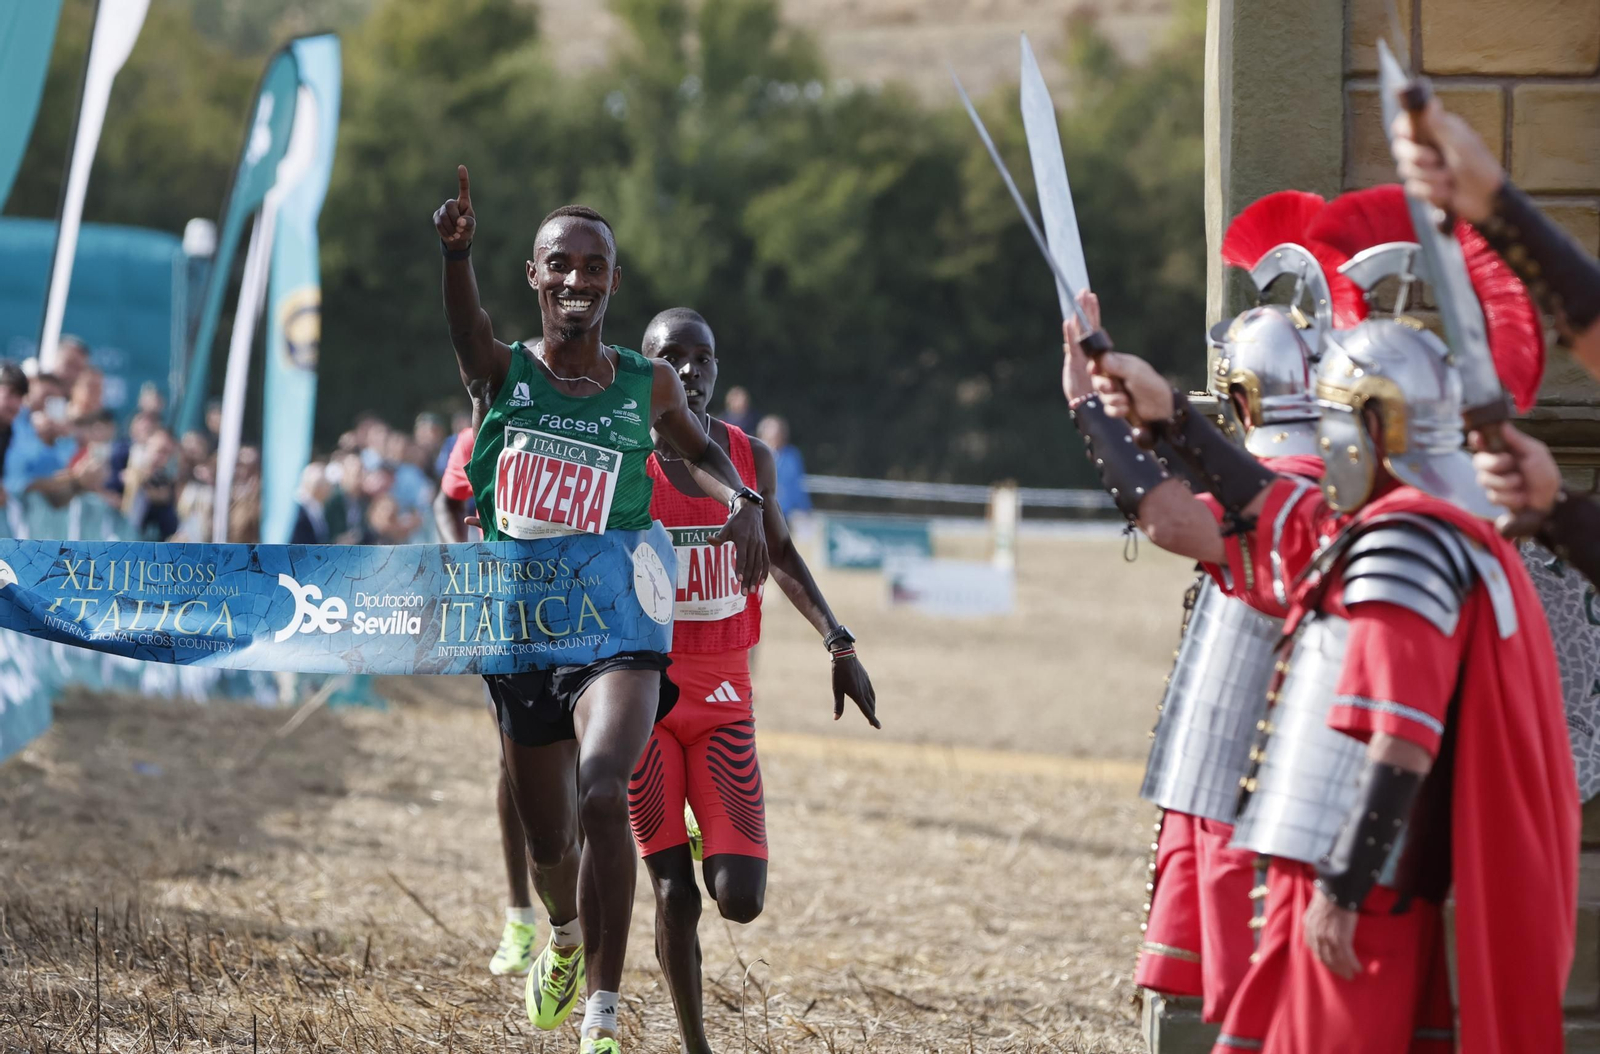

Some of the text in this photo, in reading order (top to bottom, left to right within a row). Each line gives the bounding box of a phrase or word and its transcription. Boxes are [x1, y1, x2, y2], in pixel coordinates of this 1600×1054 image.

[532, 437, 588, 462] ITÁLICA
[497, 451, 608, 534] KWIZERA
[58, 559, 217, 593] XLIII CROSS
[146, 584, 240, 597] INTERNACIONAL
[444, 556, 571, 596] XLIII CROSS
[502, 575, 603, 596] INTERNACIONAL
[354, 591, 424, 608] Diputación
[47, 591, 235, 640] ITÁLICA
[351, 612, 422, 636] Sevilla
[438, 592, 611, 643] ITÁLICA
[43, 614, 235, 654] INTERNATIONAL CROSS COUNTRY
[437, 633, 611, 657] INTERNATIONAL CROSS COUNTRY
